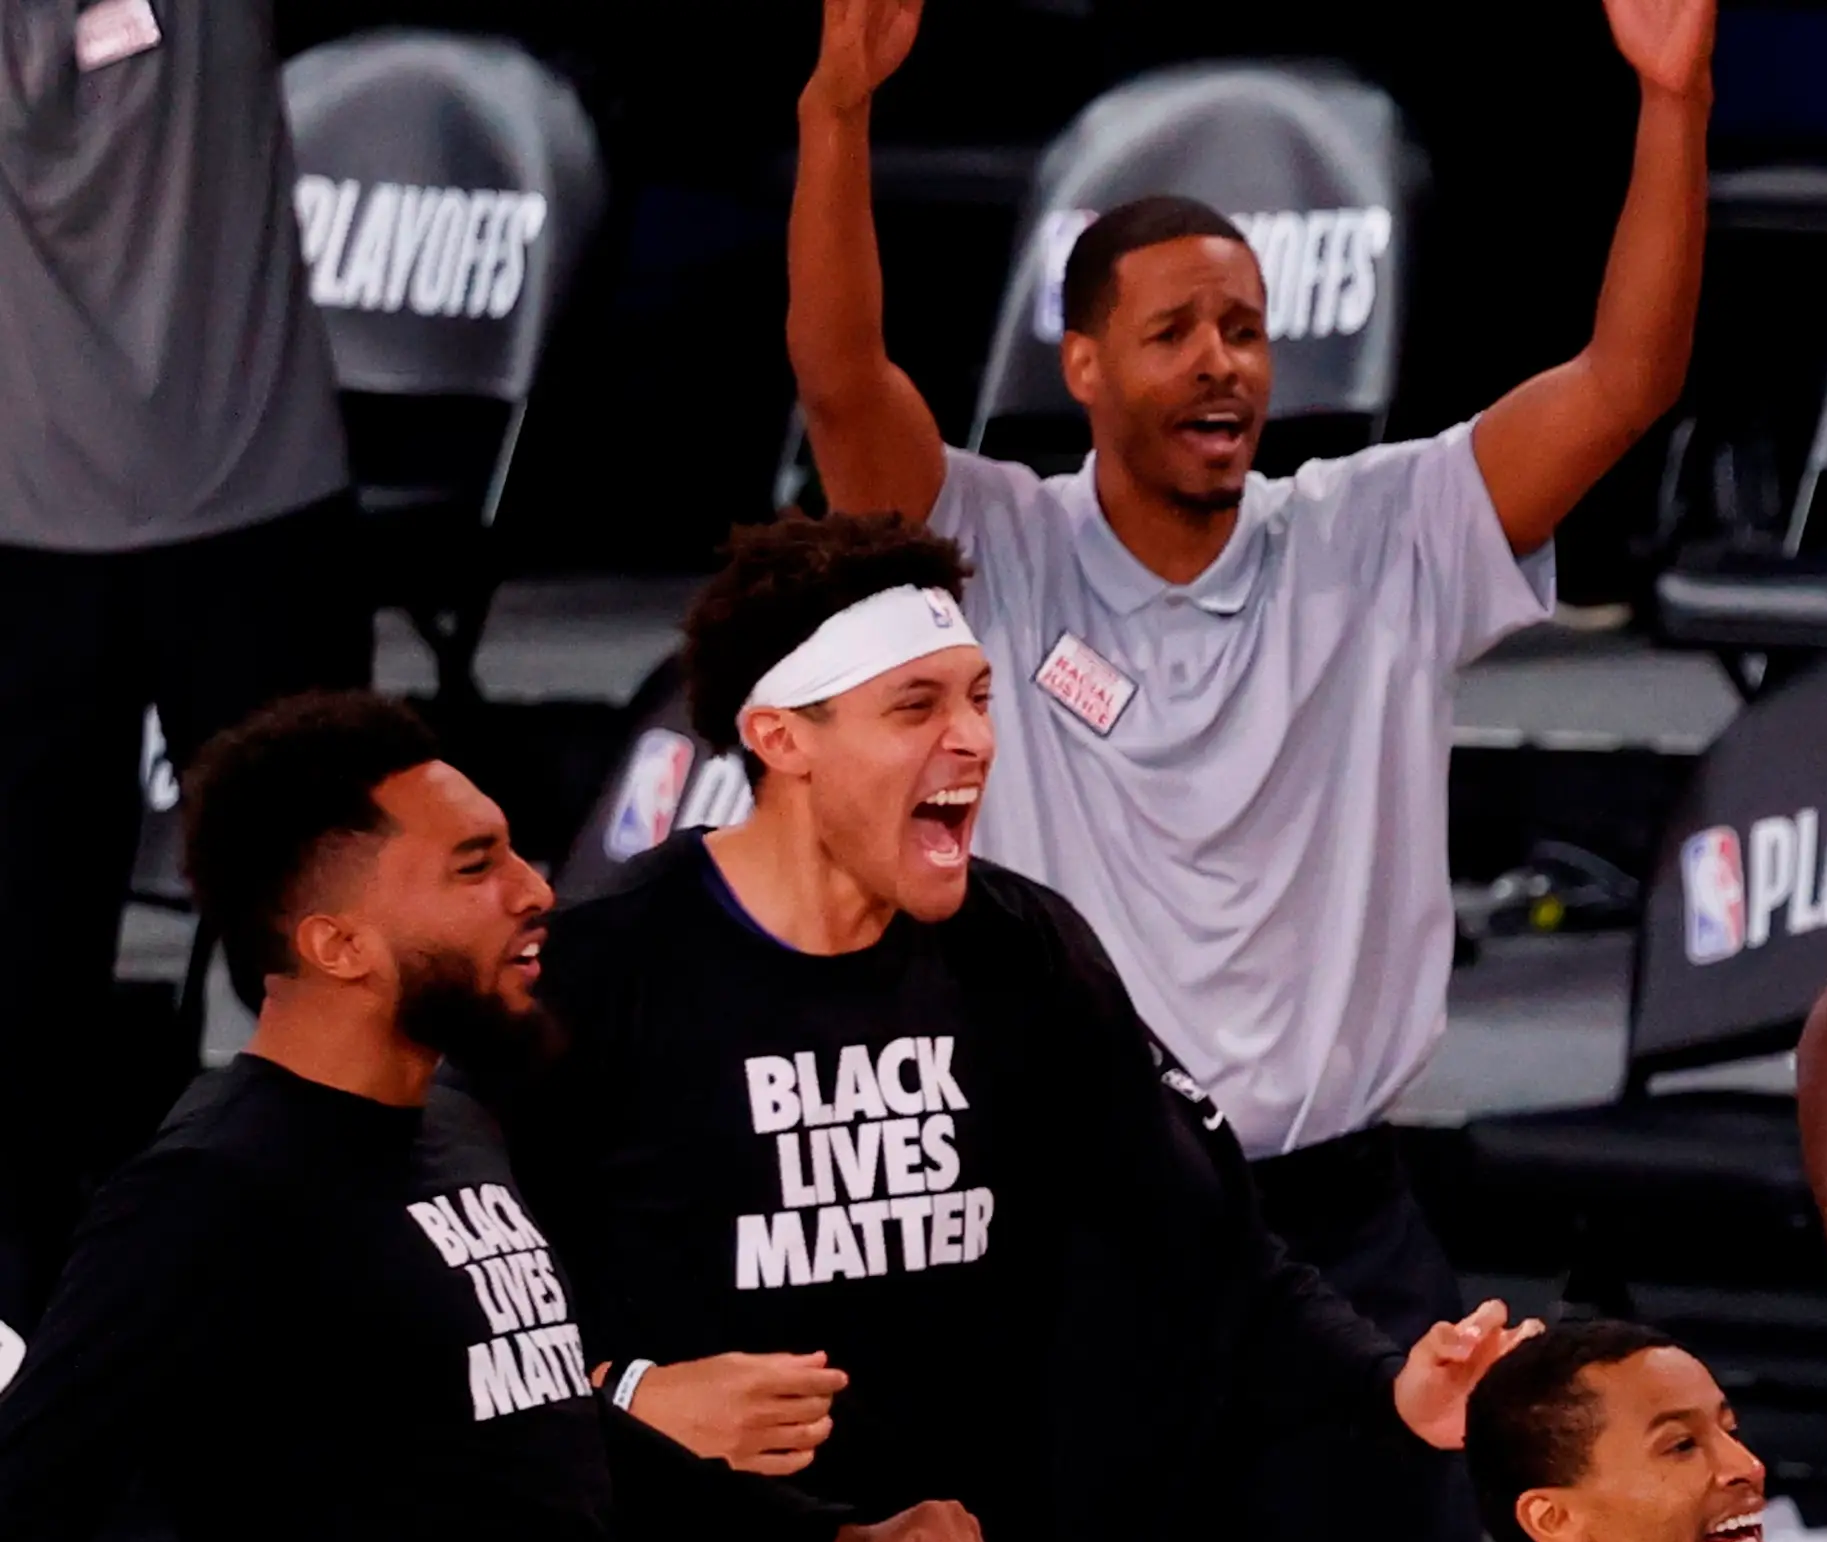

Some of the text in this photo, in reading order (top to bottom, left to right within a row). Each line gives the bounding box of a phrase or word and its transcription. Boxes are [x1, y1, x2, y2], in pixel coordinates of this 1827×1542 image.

[744, 1036, 968, 1134] BLACK
[777, 1113, 960, 1208] LIVES
[407, 1183, 549, 1268] BLACK
[735, 1188, 993, 1290] MATTER
[465, 1249, 567, 1335] LIVES
[467, 1324, 593, 1422] MATT
